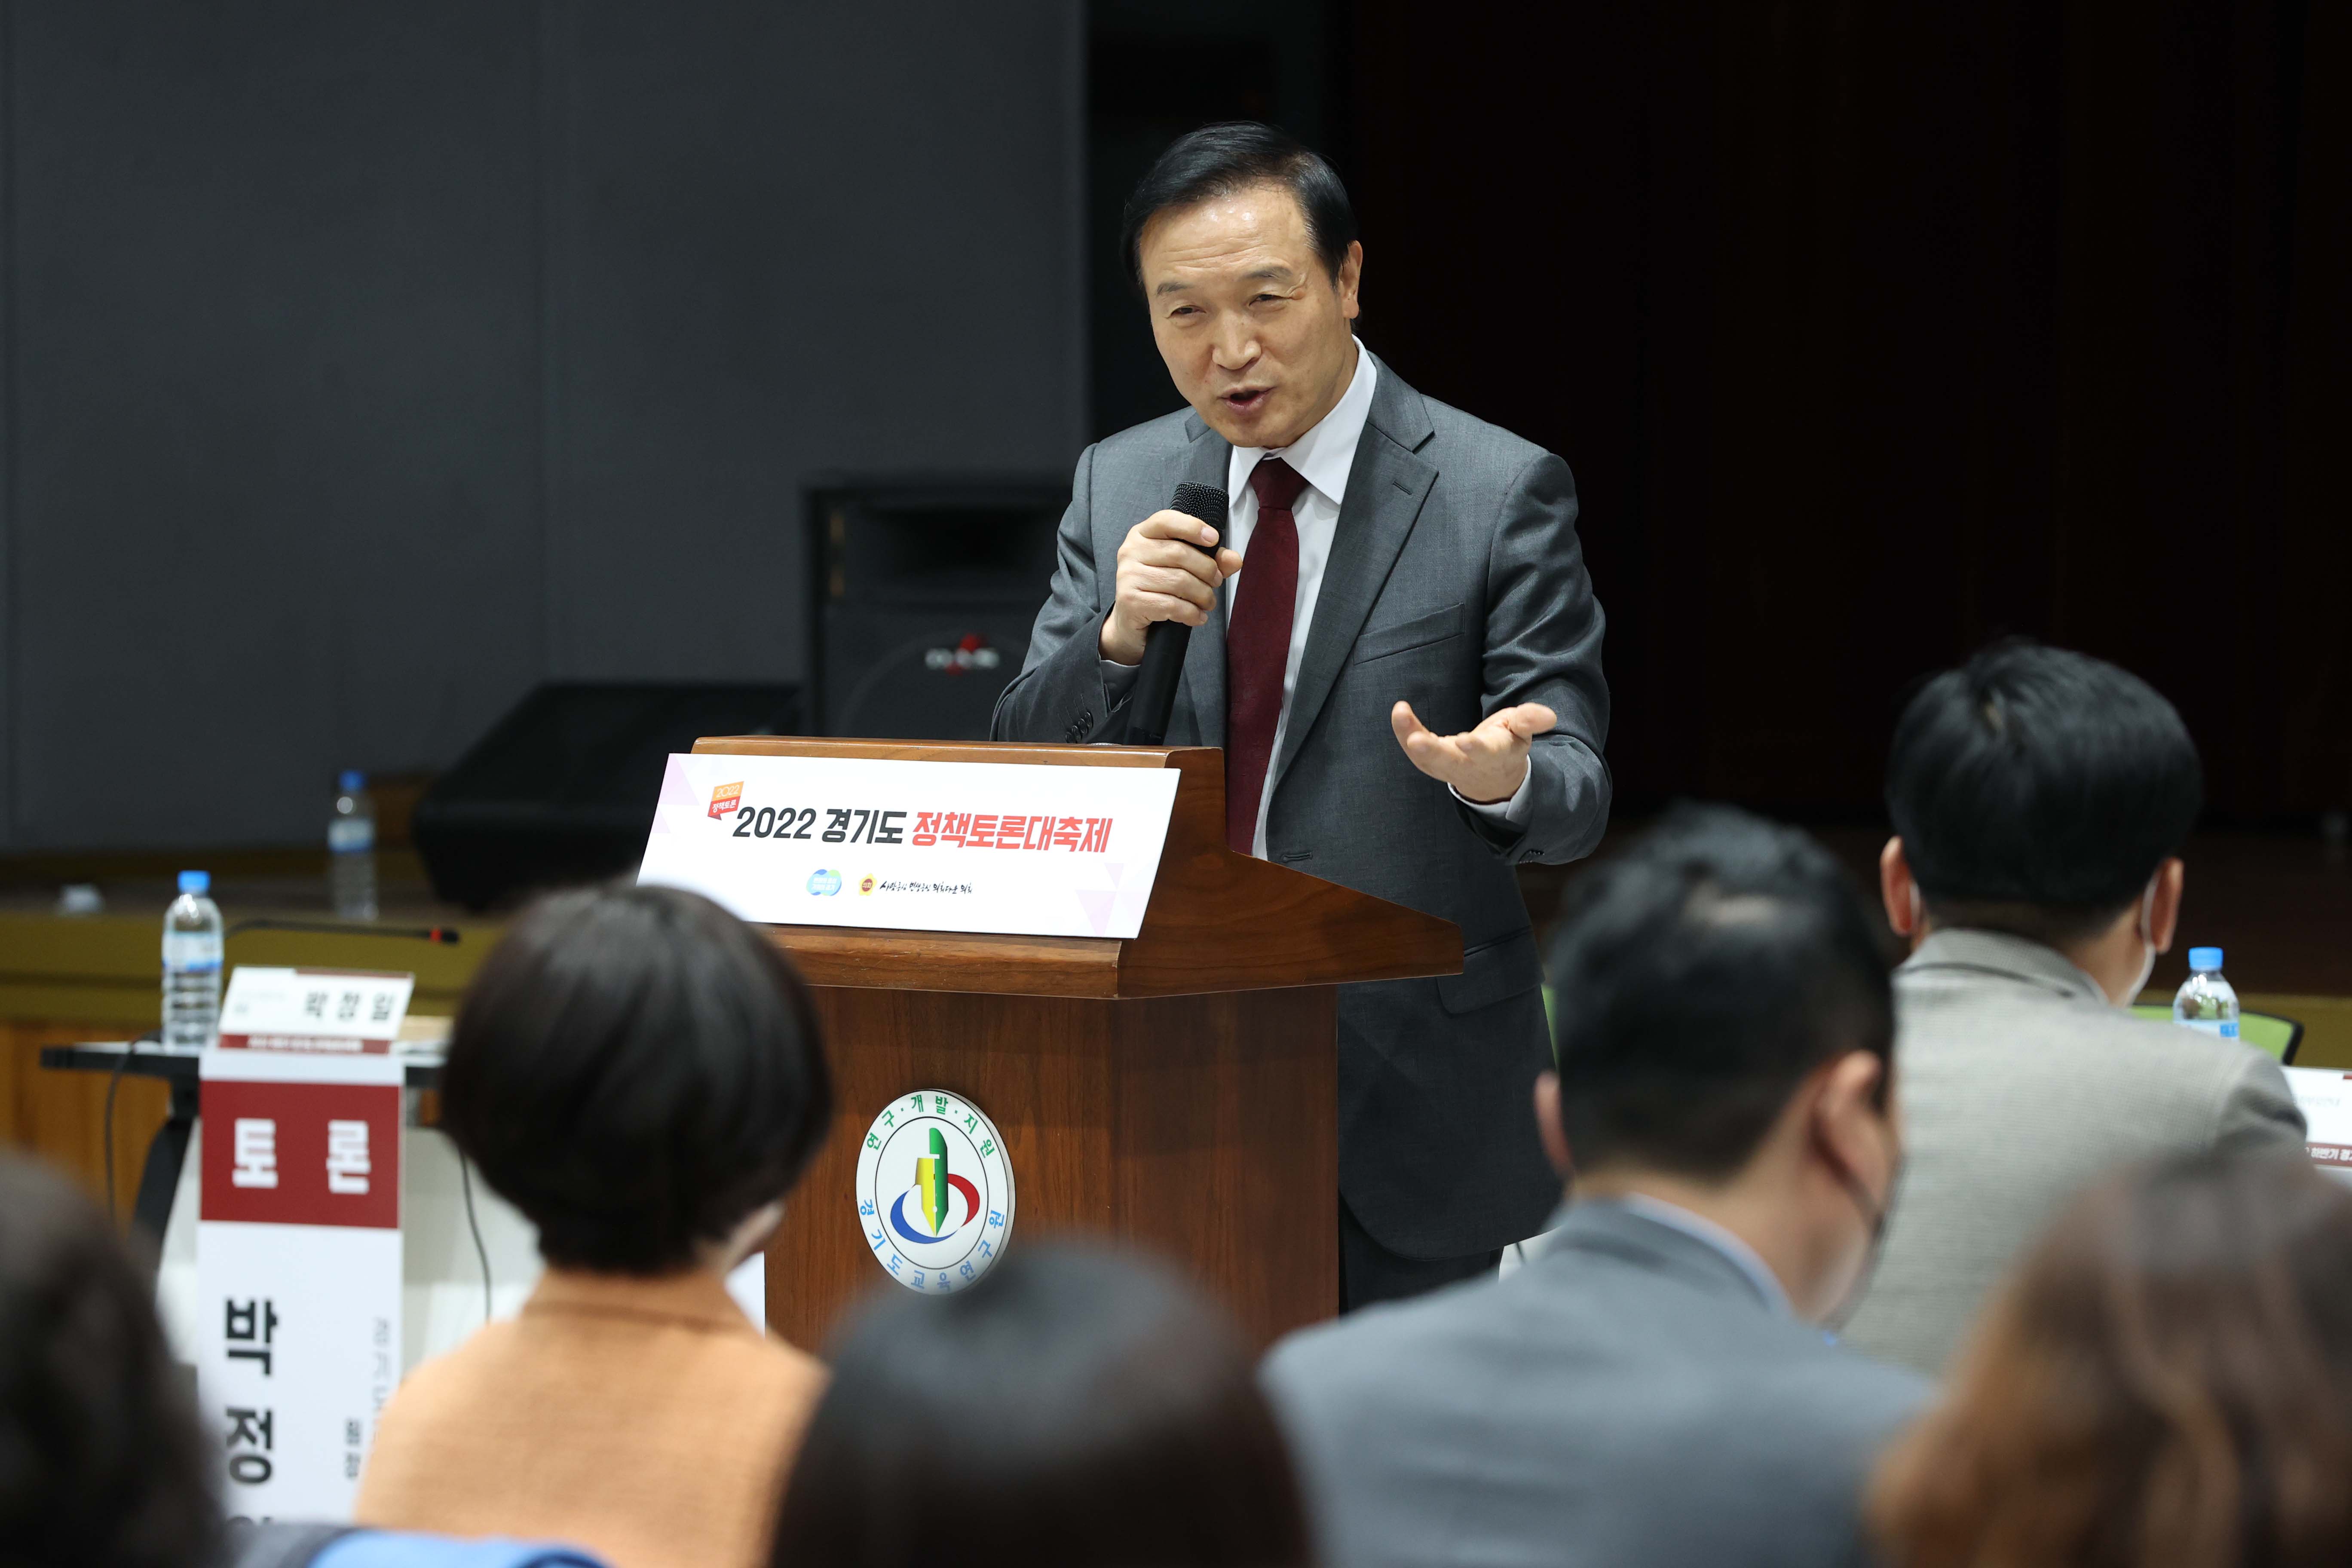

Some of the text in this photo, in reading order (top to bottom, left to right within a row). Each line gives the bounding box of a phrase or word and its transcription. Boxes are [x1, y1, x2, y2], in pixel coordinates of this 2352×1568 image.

[716, 784, 740, 798] 2022
[712, 799, 736, 813] 정책토론
[733, 806, 1113, 854] 2022 경기도 정책토론대축제
[961, 882, 973, 894] 의회
[226, 1299, 278, 1525] 박정
